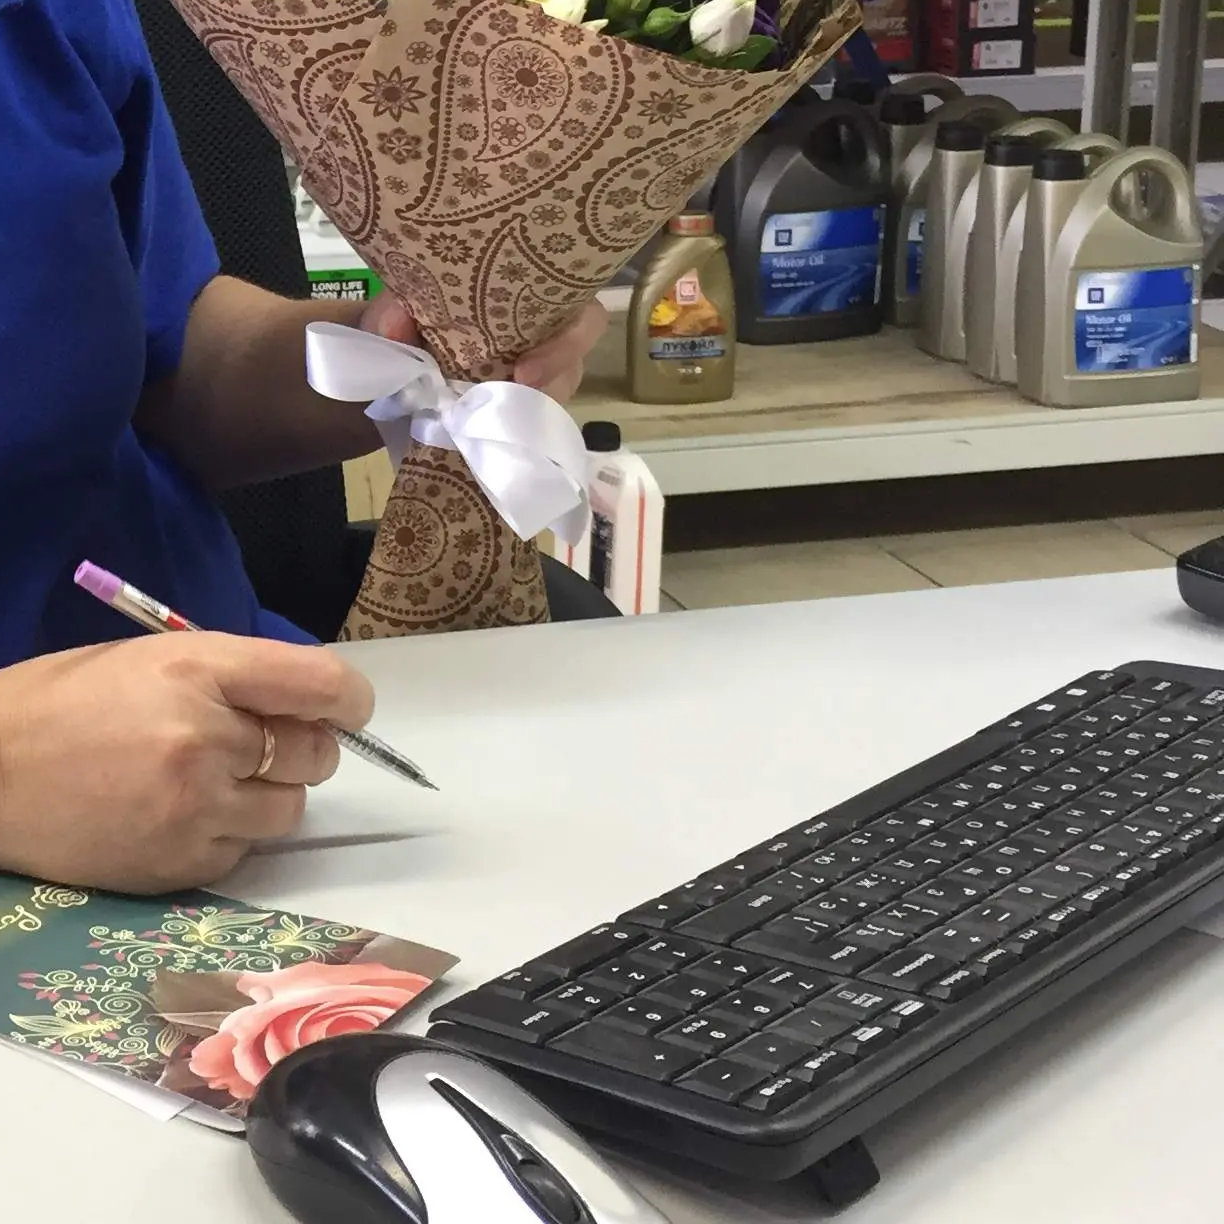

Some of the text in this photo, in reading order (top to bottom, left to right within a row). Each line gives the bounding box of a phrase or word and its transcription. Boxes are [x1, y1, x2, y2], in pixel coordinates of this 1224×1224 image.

[771, 256, 806, 268] Motor
[312, 281, 364, 292] LONG LIFE
